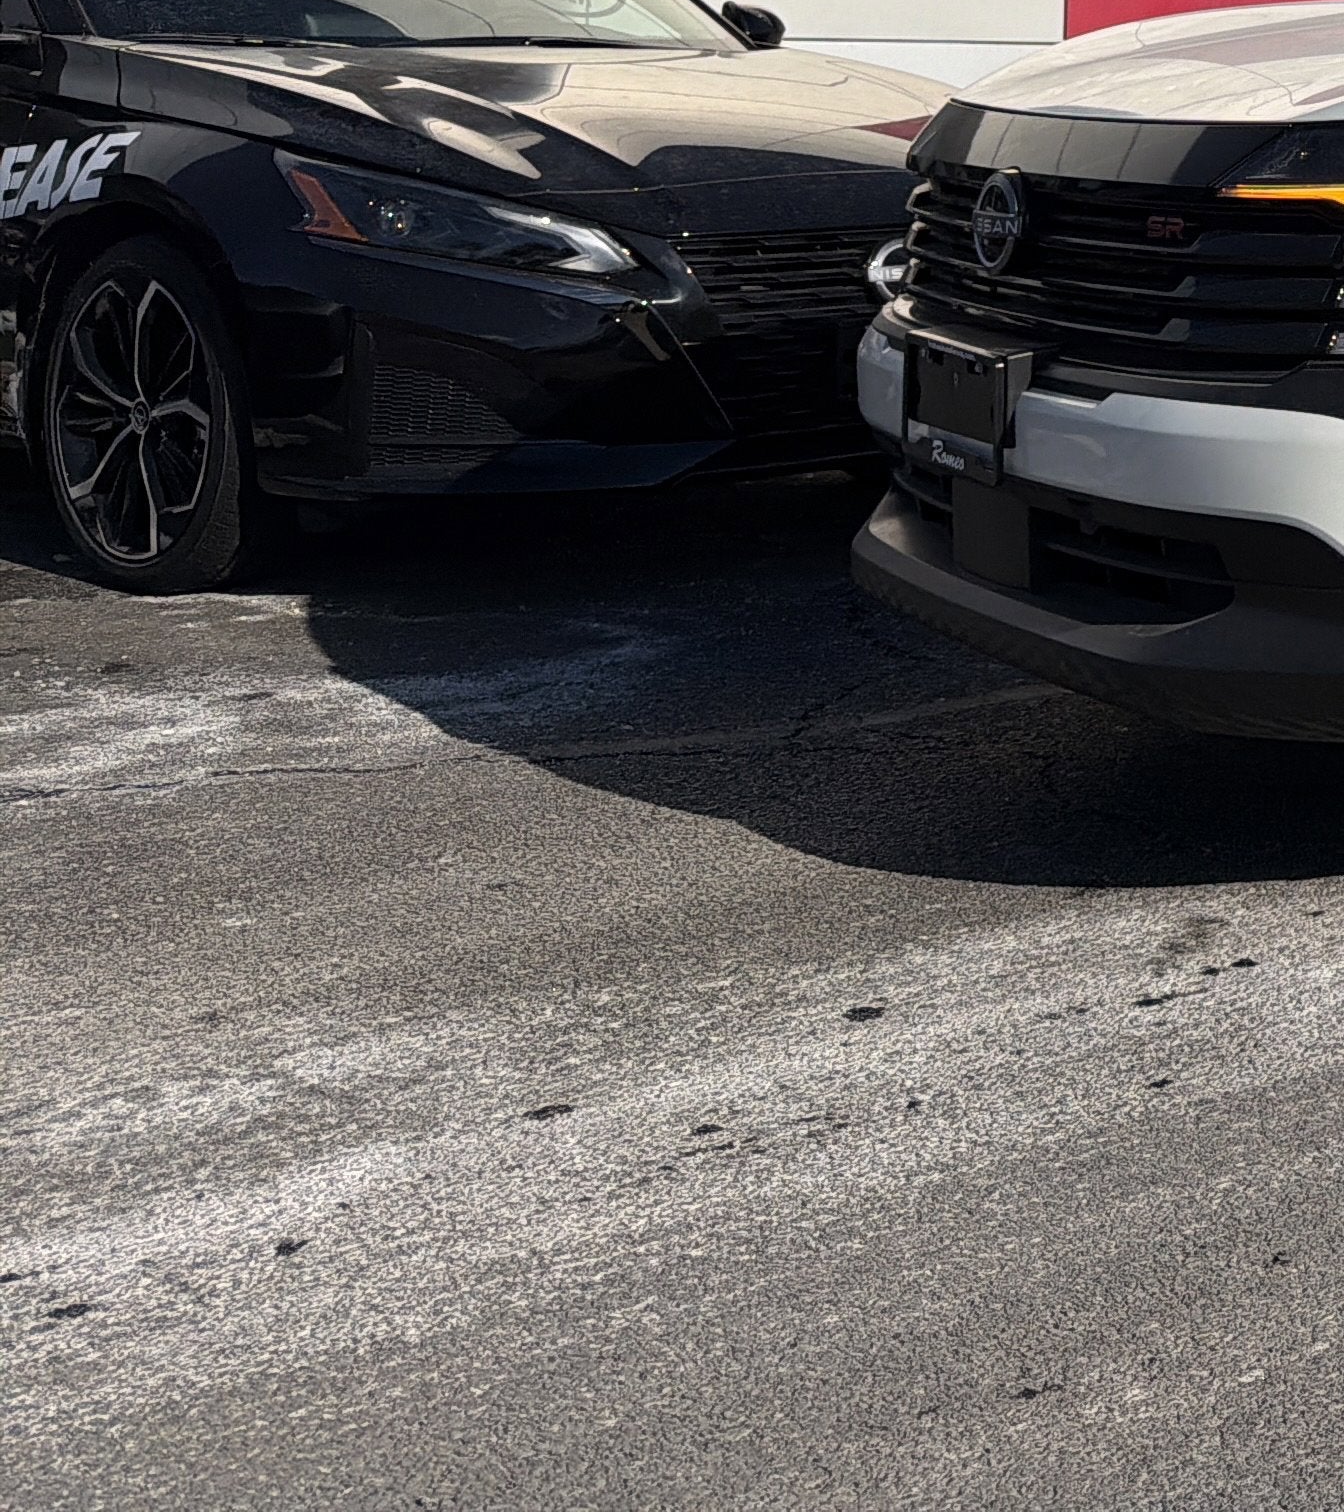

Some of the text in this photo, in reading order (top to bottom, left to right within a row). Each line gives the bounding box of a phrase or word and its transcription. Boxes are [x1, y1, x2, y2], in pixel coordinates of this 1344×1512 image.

[0, 131, 142, 220] EASE
[1147, 215, 1185, 240] SR
[870, 267, 904, 280] NIS
[931, 439, 965, 471] Romeo
